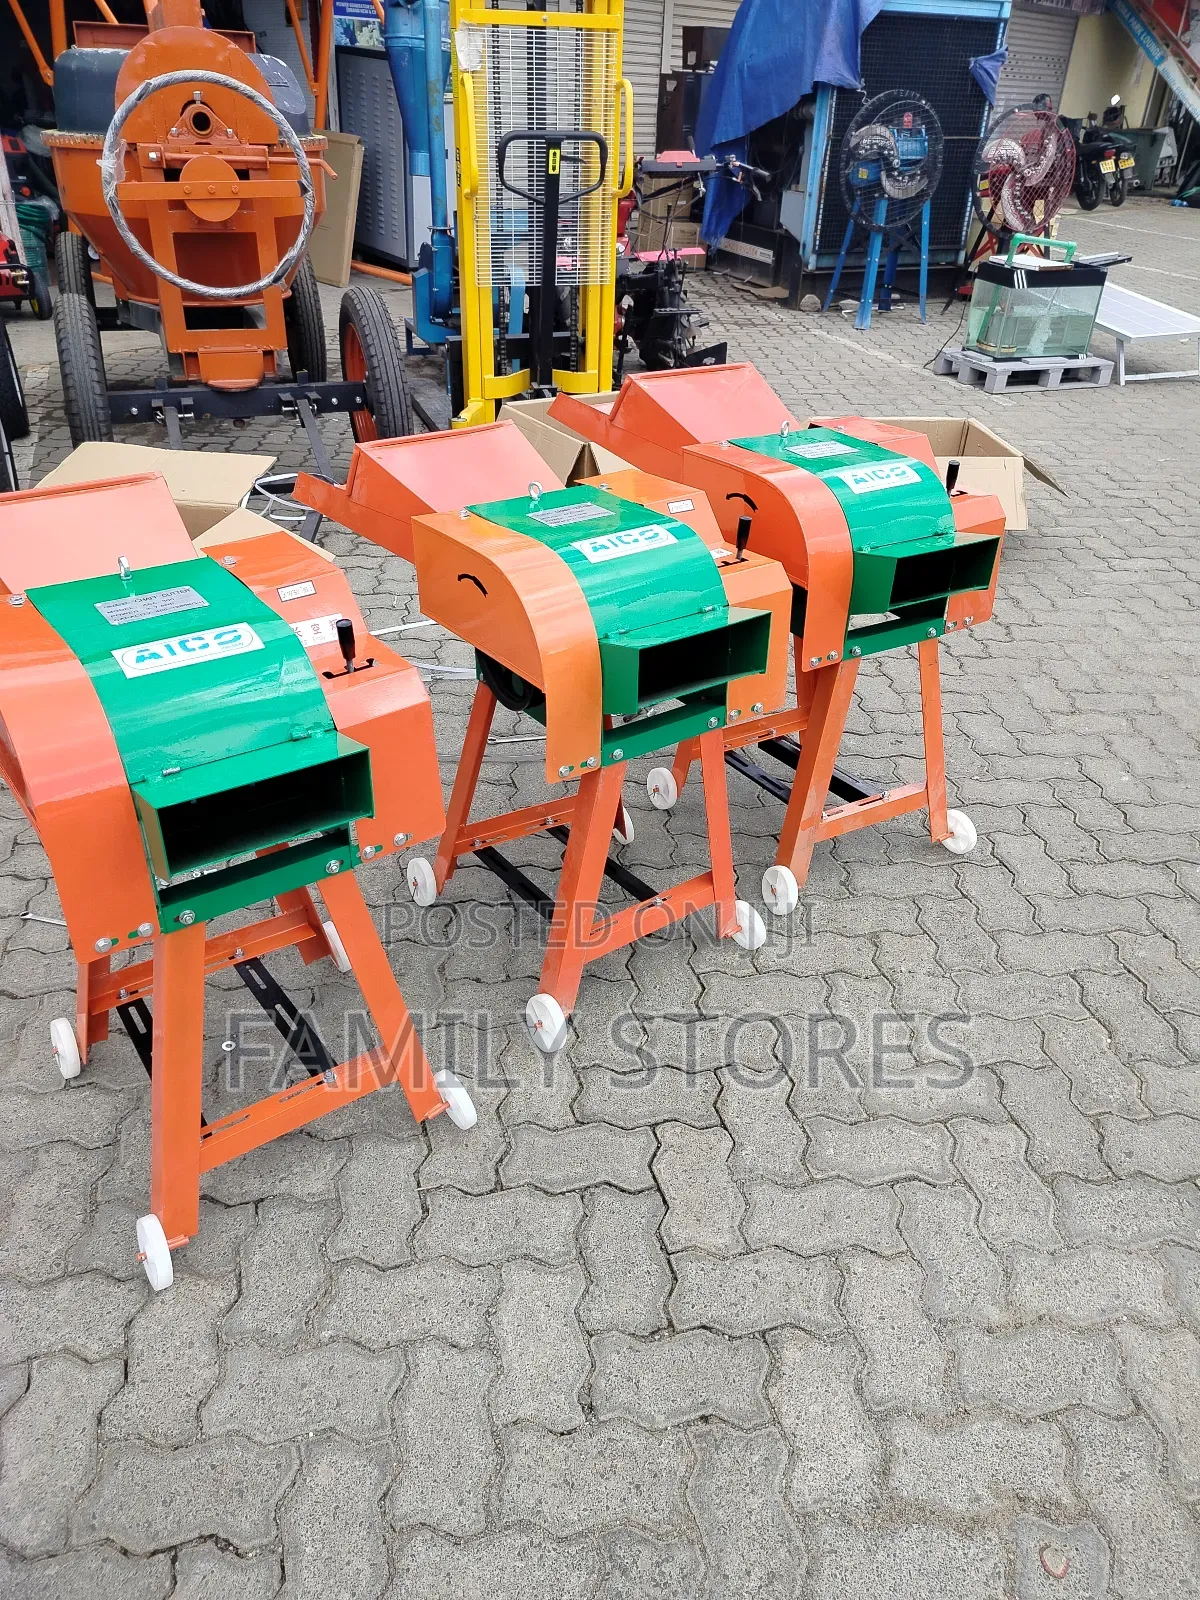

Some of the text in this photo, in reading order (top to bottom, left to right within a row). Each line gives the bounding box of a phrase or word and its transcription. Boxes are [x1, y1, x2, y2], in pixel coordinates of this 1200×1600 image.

[1129, 16, 1143, 36] PARK
[1140, 32, 1163, 60] LOUNGE
[851, 466, 907, 485] AICS
[589, 528, 660, 553] AICS
[135, 629, 242, 664] AICS
